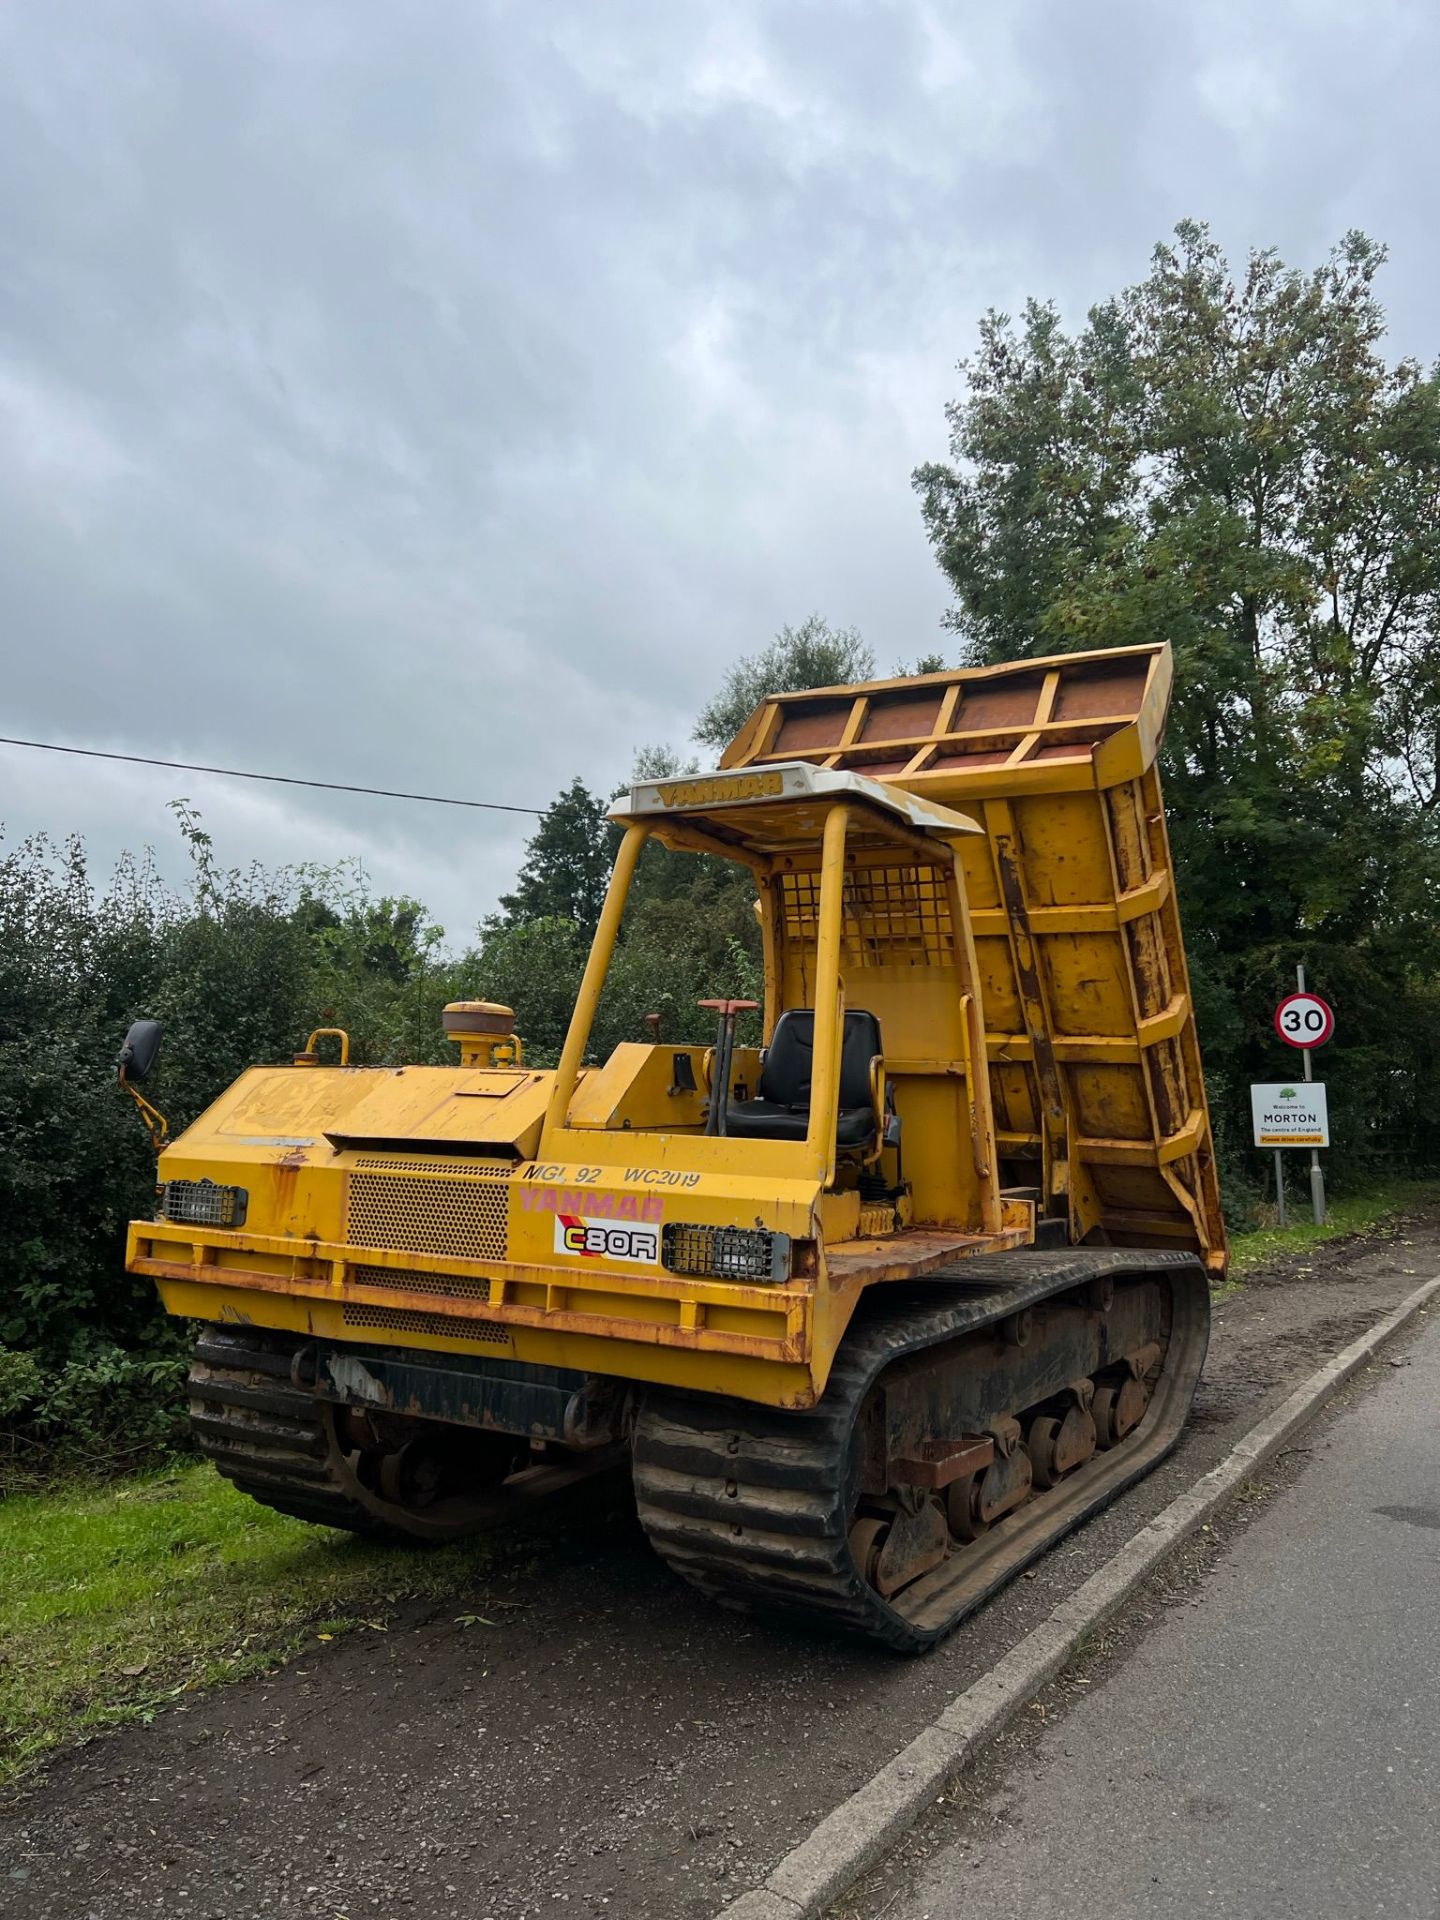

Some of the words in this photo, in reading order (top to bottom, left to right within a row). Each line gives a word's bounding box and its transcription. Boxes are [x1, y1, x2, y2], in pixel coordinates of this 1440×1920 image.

[1284, 1010, 1323, 1032] 30
[1264, 1114, 1316, 1123] MORTON
[575, 1167, 602, 1184] 92
[623, 1168, 701, 1188] WC2019
[519, 1186, 666, 1224] YANMAR
[564, 1225, 657, 1260] C80R
